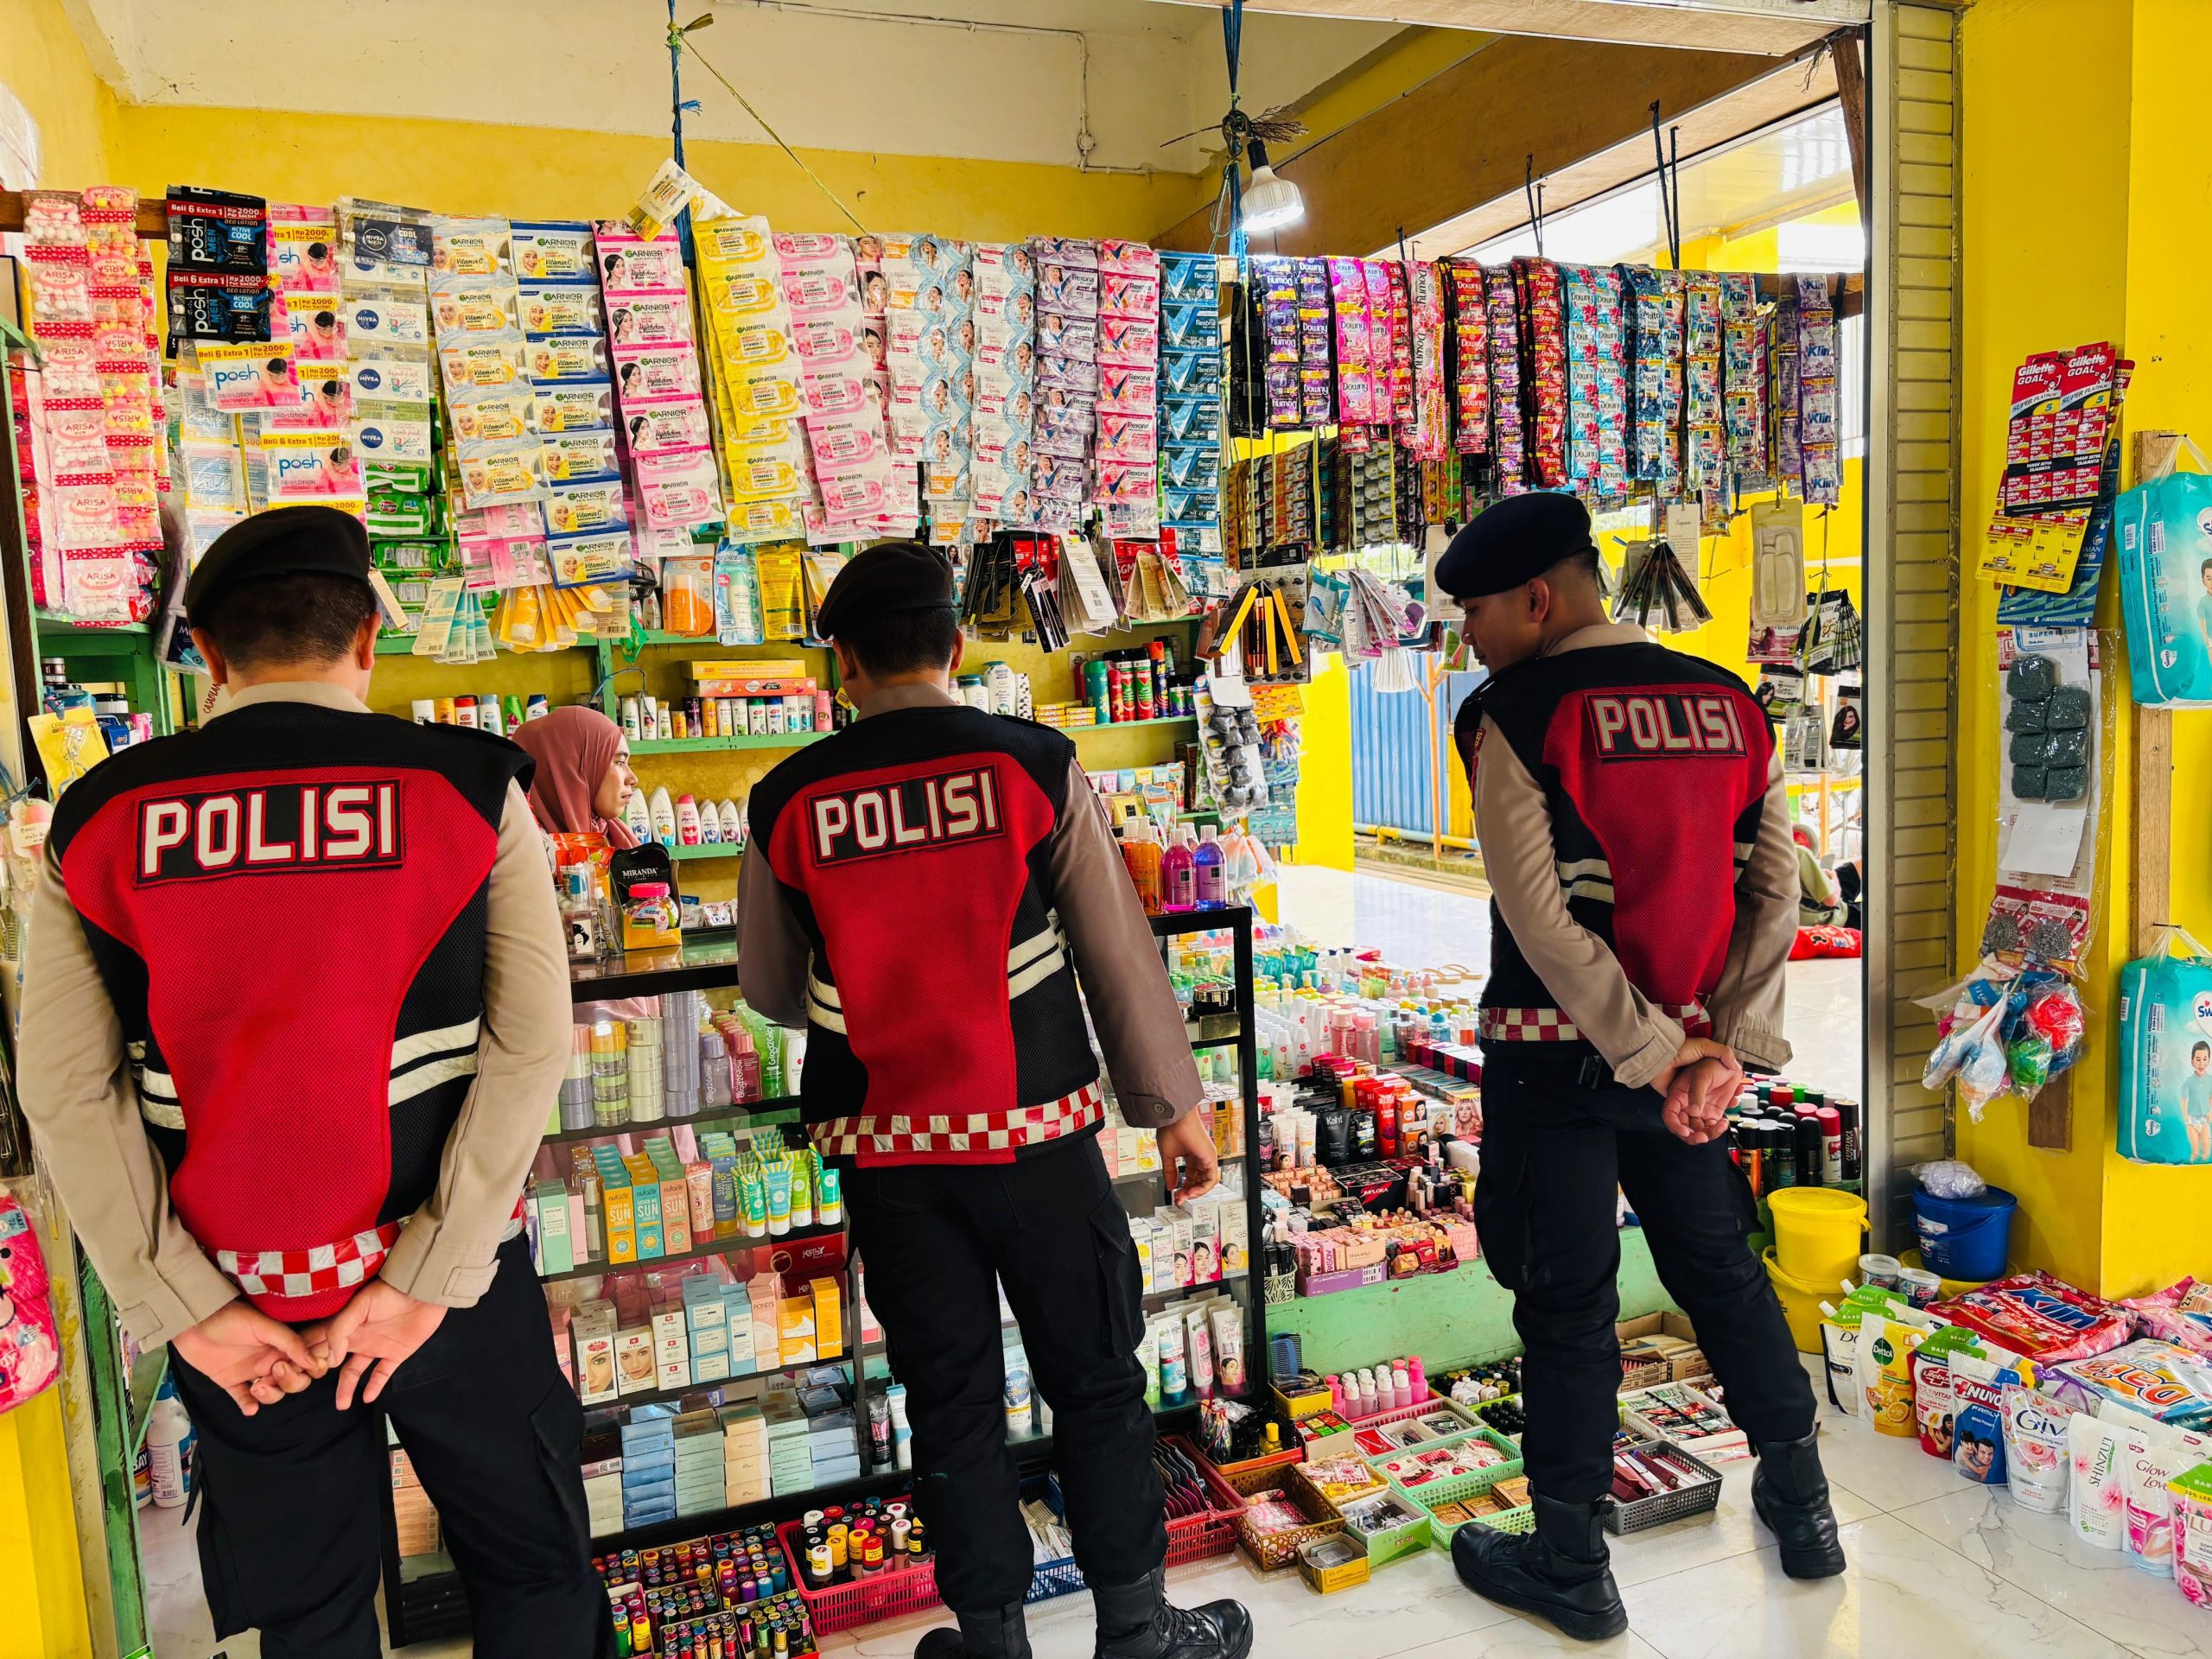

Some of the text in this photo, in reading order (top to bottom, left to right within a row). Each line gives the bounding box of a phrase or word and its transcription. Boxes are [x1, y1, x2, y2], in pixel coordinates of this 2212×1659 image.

[37, 196, 69, 207] ARISA
[183, 219, 214, 262] posh
[96, 264, 125, 273] ARISA
[1300, 263, 1325, 272] Downy
[45, 270, 75, 279] ARISA
[1071, 274, 1094, 283] Rexona
[1267, 276, 1292, 285] Downy
[1416, 270, 1427, 304] Downy
[1457, 281, 1481, 290] Downy
[1571, 293, 1593, 302] Downy
[1729, 292, 1748, 302] Klin
[185, 289, 218, 334] posh
[210, 299, 219, 322] MEN
[1303, 322, 1327, 333] Downy
[1341, 321, 1366, 331] Downy
[54, 346, 85, 356] ARISA
[1415, 333, 1426, 370] Downy
[1807, 346, 1829, 356] Klin
[1732, 360, 1751, 370] Klin
[2069, 354, 2106, 367] Gillette
[2018, 363, 2056, 376] Gillette
[2068, 365, 2094, 377] GOAL
[215, 364, 259, 390] posh
[748, 376, 777, 385] GARNIER
[2018, 376, 2044, 385] GOAL
[1304, 385, 1328, 394] Downy
[556, 392, 594, 401] GARNIER
[2062, 392, 2083, 404] SUPER
[2096, 395, 2103, 404] 5
[2012, 400, 2033, 412] SUPER
[650, 410, 686, 418] GARNIER
[1574, 411, 1596, 420] Downy
[1809, 414, 1831, 423] Klin
[65, 423, 94, 431] ARISA
[279, 452, 322, 476] posh
[576, 542, 613, 552] GARNIER
[204, 683, 220, 714] CASABLAN
[1592, 698, 1744, 751] POLISI
[815, 771, 997, 858] POLISI
[142, 785, 396, 877] POLISI
[622, 868, 657, 877] MIRANDA
[1327, 1116, 1343, 1124] Kahf
[638, 1205, 658, 1217] SUN
[665, 1200, 685, 1213] SUN
[610, 1209, 631, 1221] SUN
[1873, 1345, 1893, 1357] Dettol
[1923, 1370, 1950, 1382] Lifebu
[2075, 1360, 2191, 1408] Daia
[1966, 1384, 2002, 1407] NUVO
[1971, 1405, 2000, 1418] FAMILY
[2015, 1409, 2067, 1436] Giv
[2136, 1459, 2171, 1478] Glow
[2143, 1477, 2167, 1491] Lov
[2190, 1517, 2212, 1535] LU
